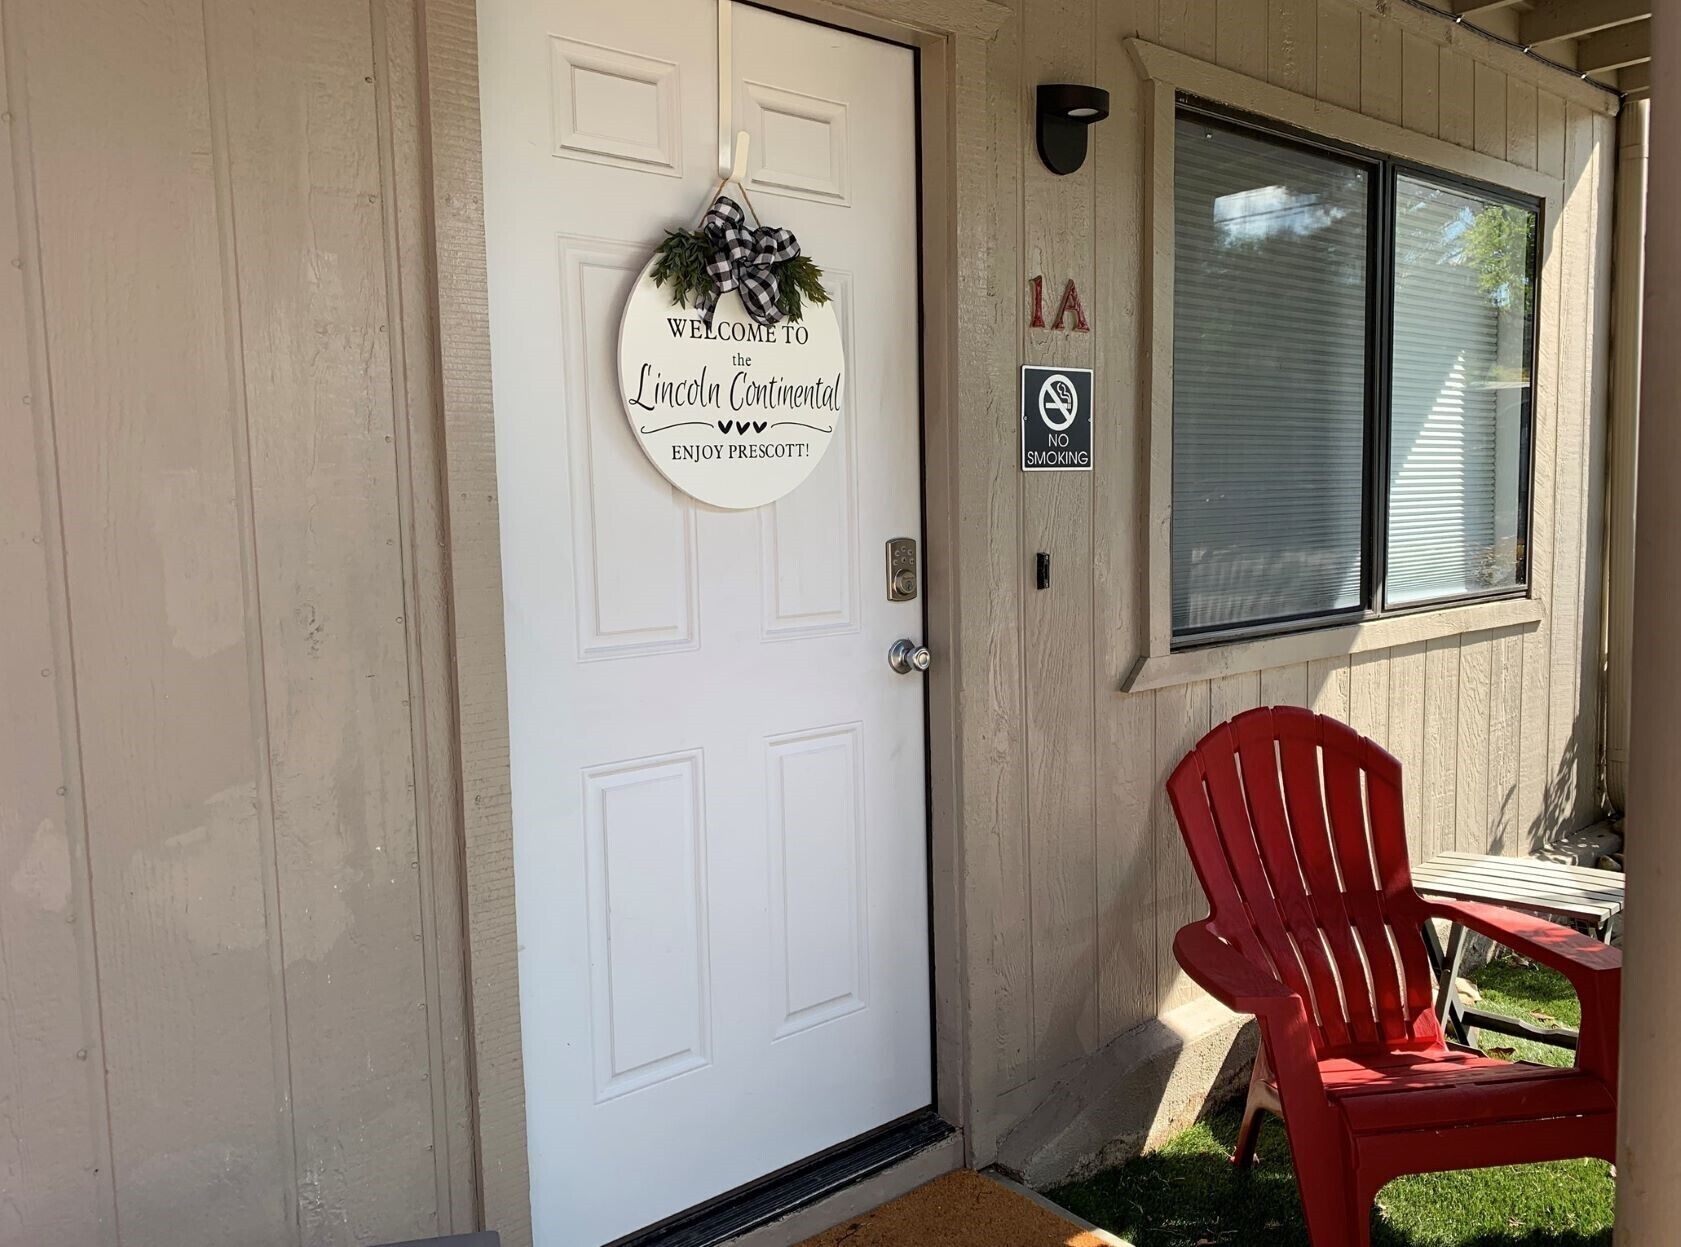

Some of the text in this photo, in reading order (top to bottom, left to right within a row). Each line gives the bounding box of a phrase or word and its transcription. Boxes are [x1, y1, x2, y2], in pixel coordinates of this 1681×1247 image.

[1029, 275, 1090, 333] 1A
[667, 317, 809, 345] WELCOME TO
[732, 352, 751, 366] the
[628, 362, 841, 411] Lincoln Continental
[1048, 433, 1069, 448] NO
[671, 443, 809, 463] ENJOY PRESCOTT!
[1027, 450, 1089, 465] SMOKING
